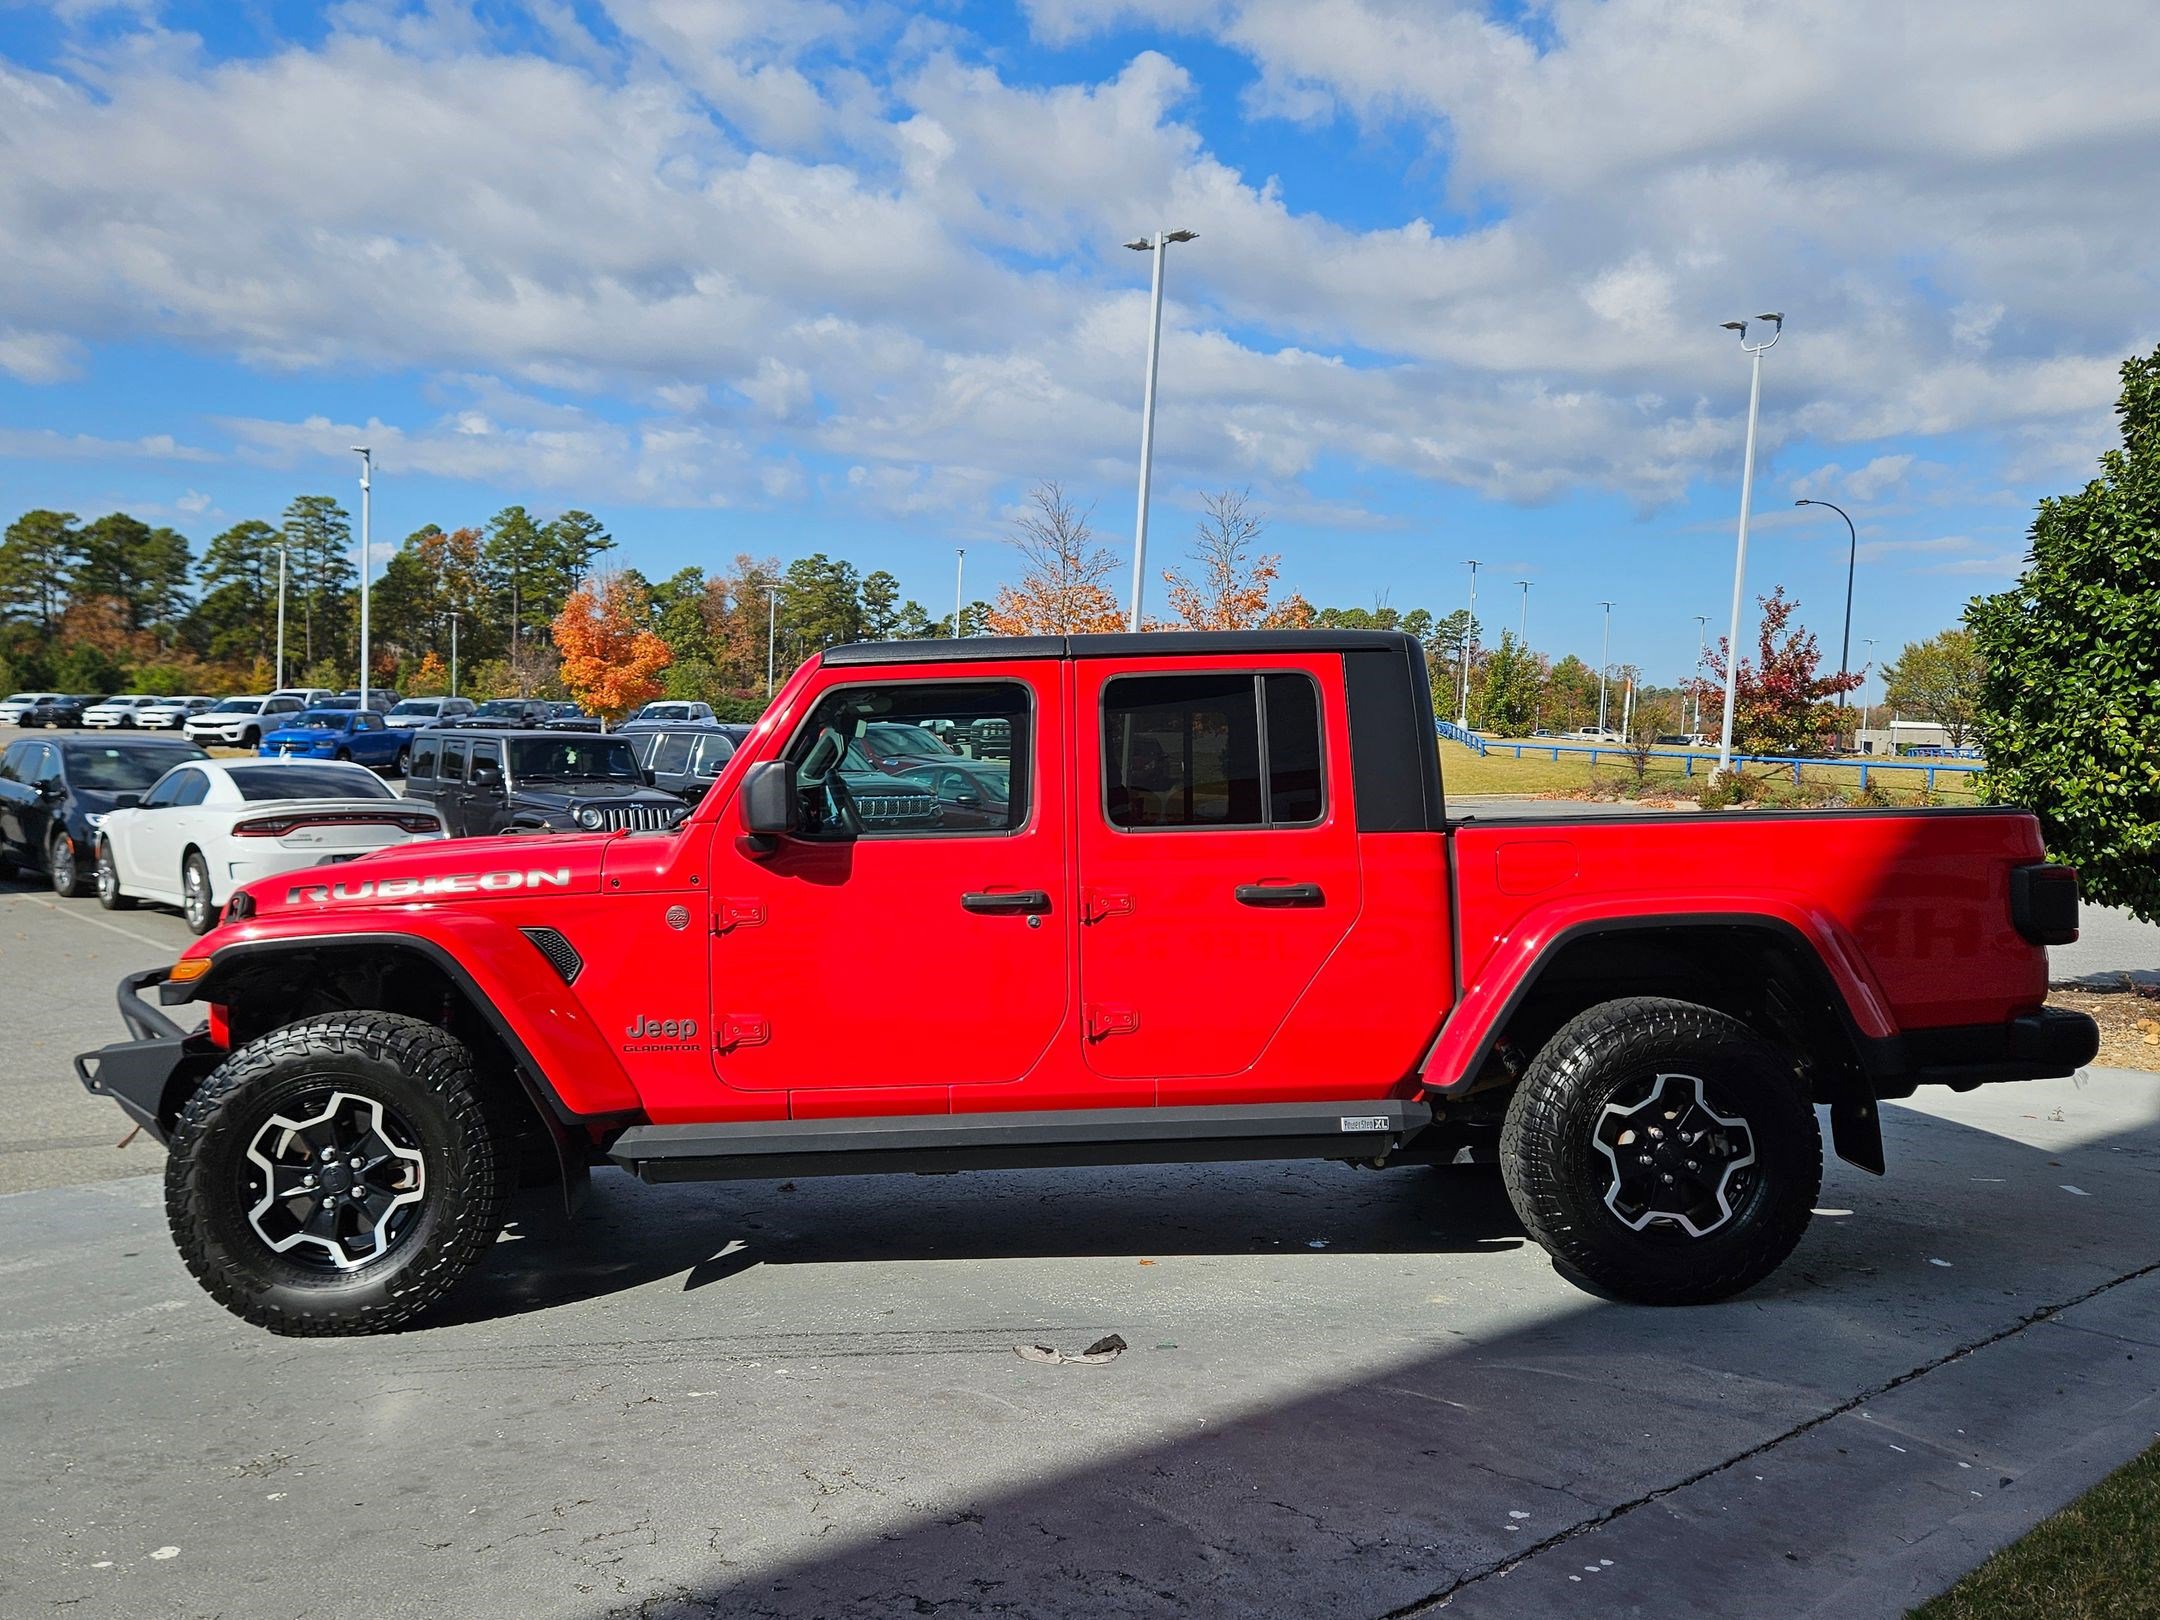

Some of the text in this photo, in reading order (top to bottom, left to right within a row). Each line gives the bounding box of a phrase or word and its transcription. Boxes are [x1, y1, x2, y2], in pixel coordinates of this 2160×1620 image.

[285, 868, 571, 905] RUBICON
[626, 1014, 698, 1041] Jeep
[623, 1044, 701, 1053] GLADIATOR
[1375, 1119, 1388, 1129] XL
